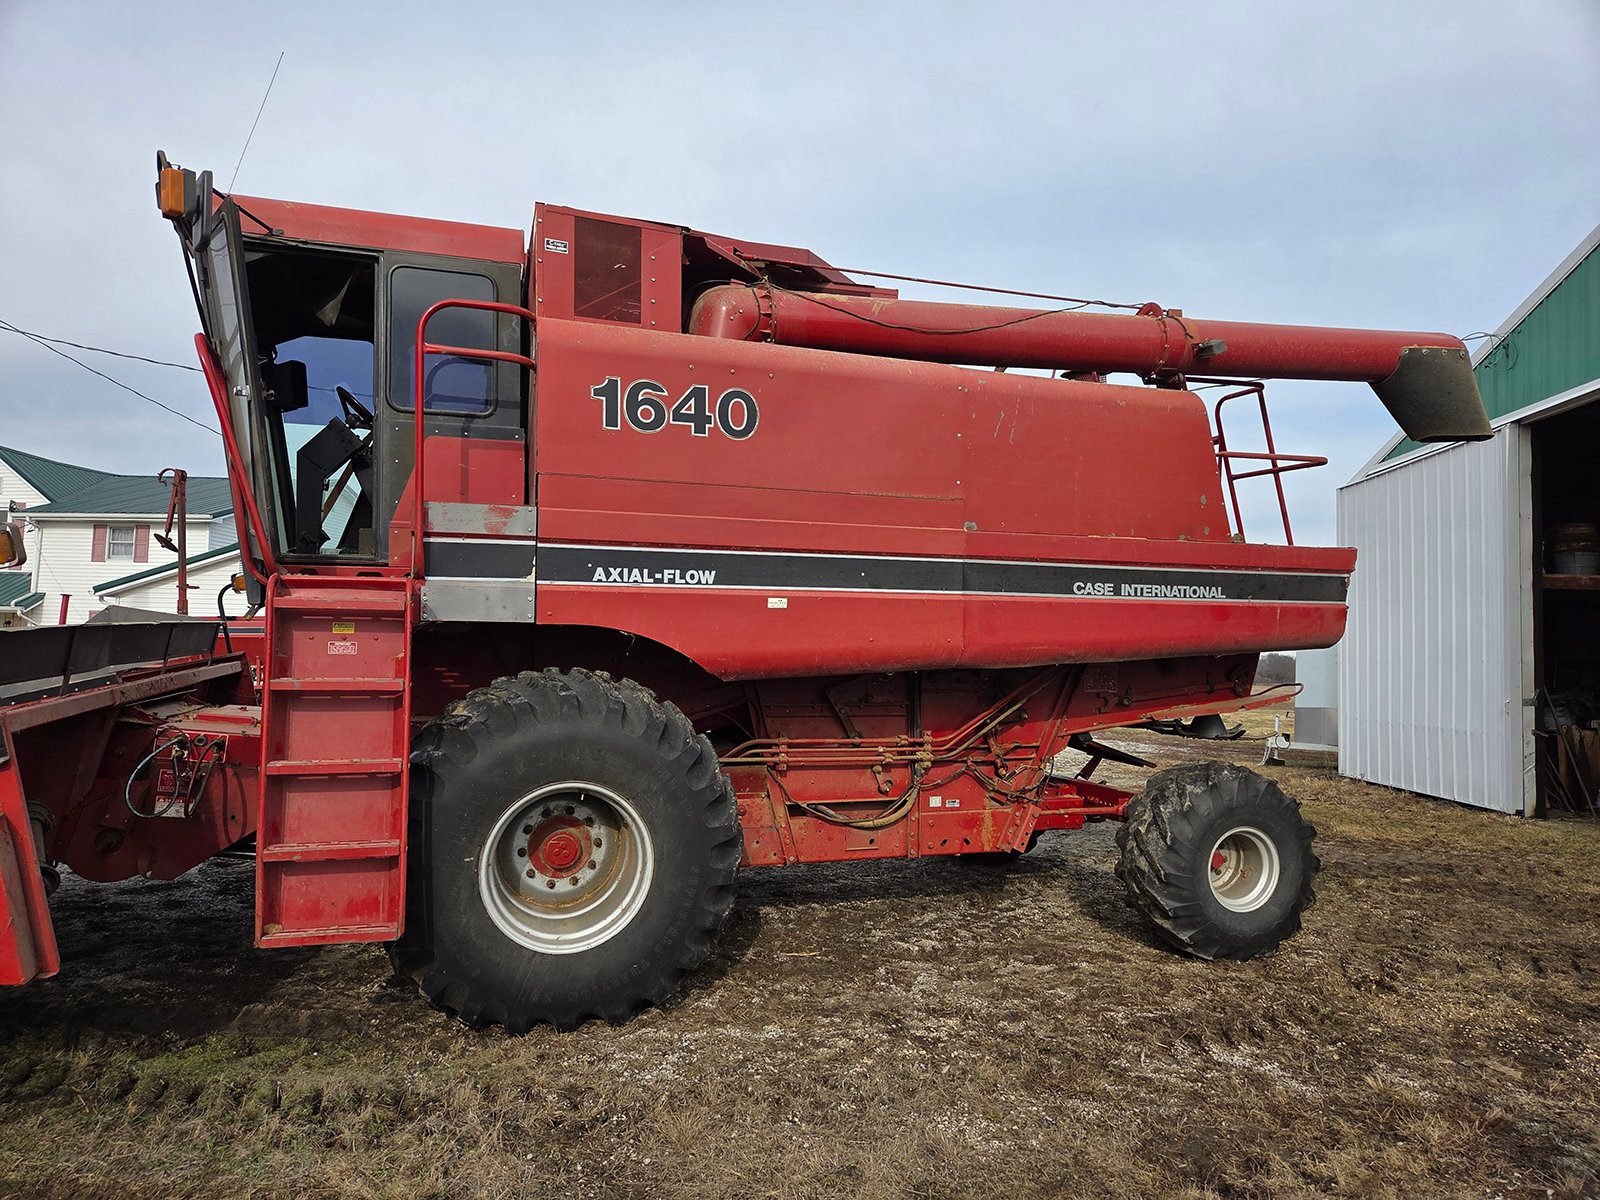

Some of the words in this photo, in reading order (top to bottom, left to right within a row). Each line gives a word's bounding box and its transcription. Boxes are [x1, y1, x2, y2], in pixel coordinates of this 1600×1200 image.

[590, 376, 760, 440] 1640
[592, 567, 716, 585] AXIAL-FLOW
[1073, 582, 1114, 596] CASE
[1121, 583, 1226, 598] INTERNATIONAL
